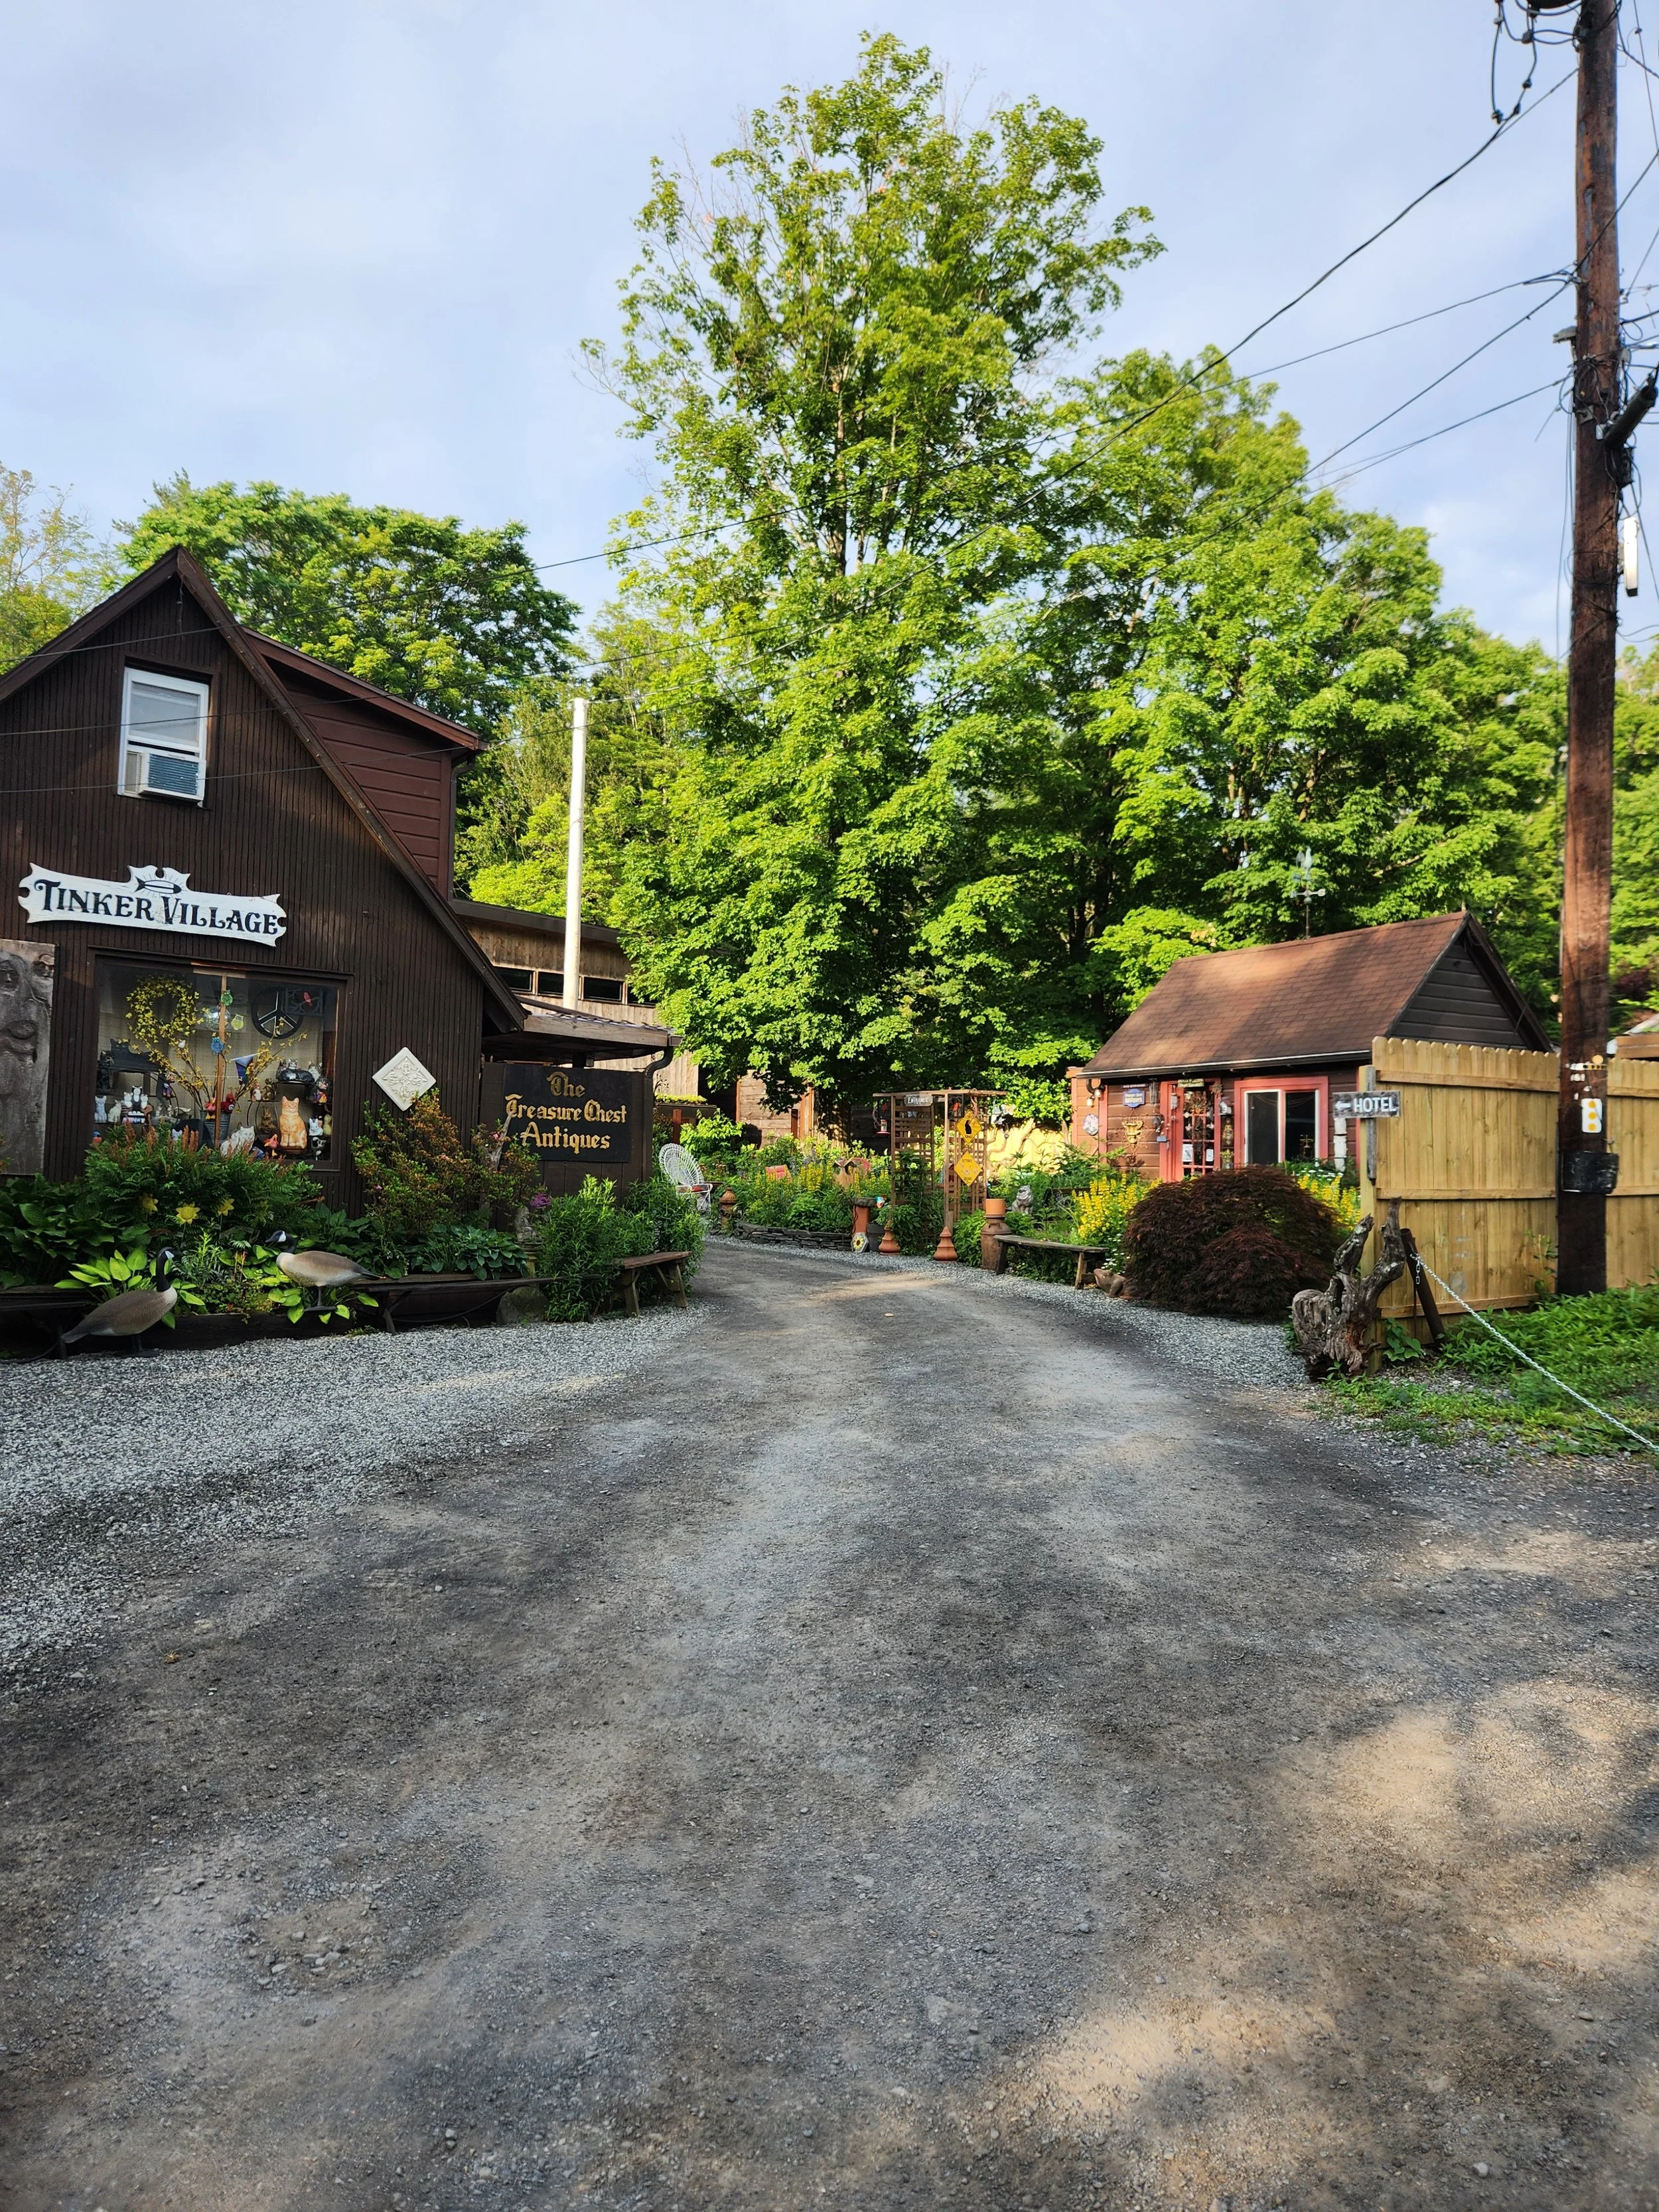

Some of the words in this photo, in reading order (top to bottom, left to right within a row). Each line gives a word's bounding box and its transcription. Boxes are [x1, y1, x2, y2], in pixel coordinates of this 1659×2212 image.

[34, 879, 155, 921] TINKER
[161, 896, 279, 934] VILLAGE
[547, 1071, 585, 1098] The
[504, 1094, 582, 1122] Treasure
[584, 1099, 627, 1124] Chest
[1353, 1096, 1397, 1112] HOTEL
[520, 1121, 611, 1155] Antiques
